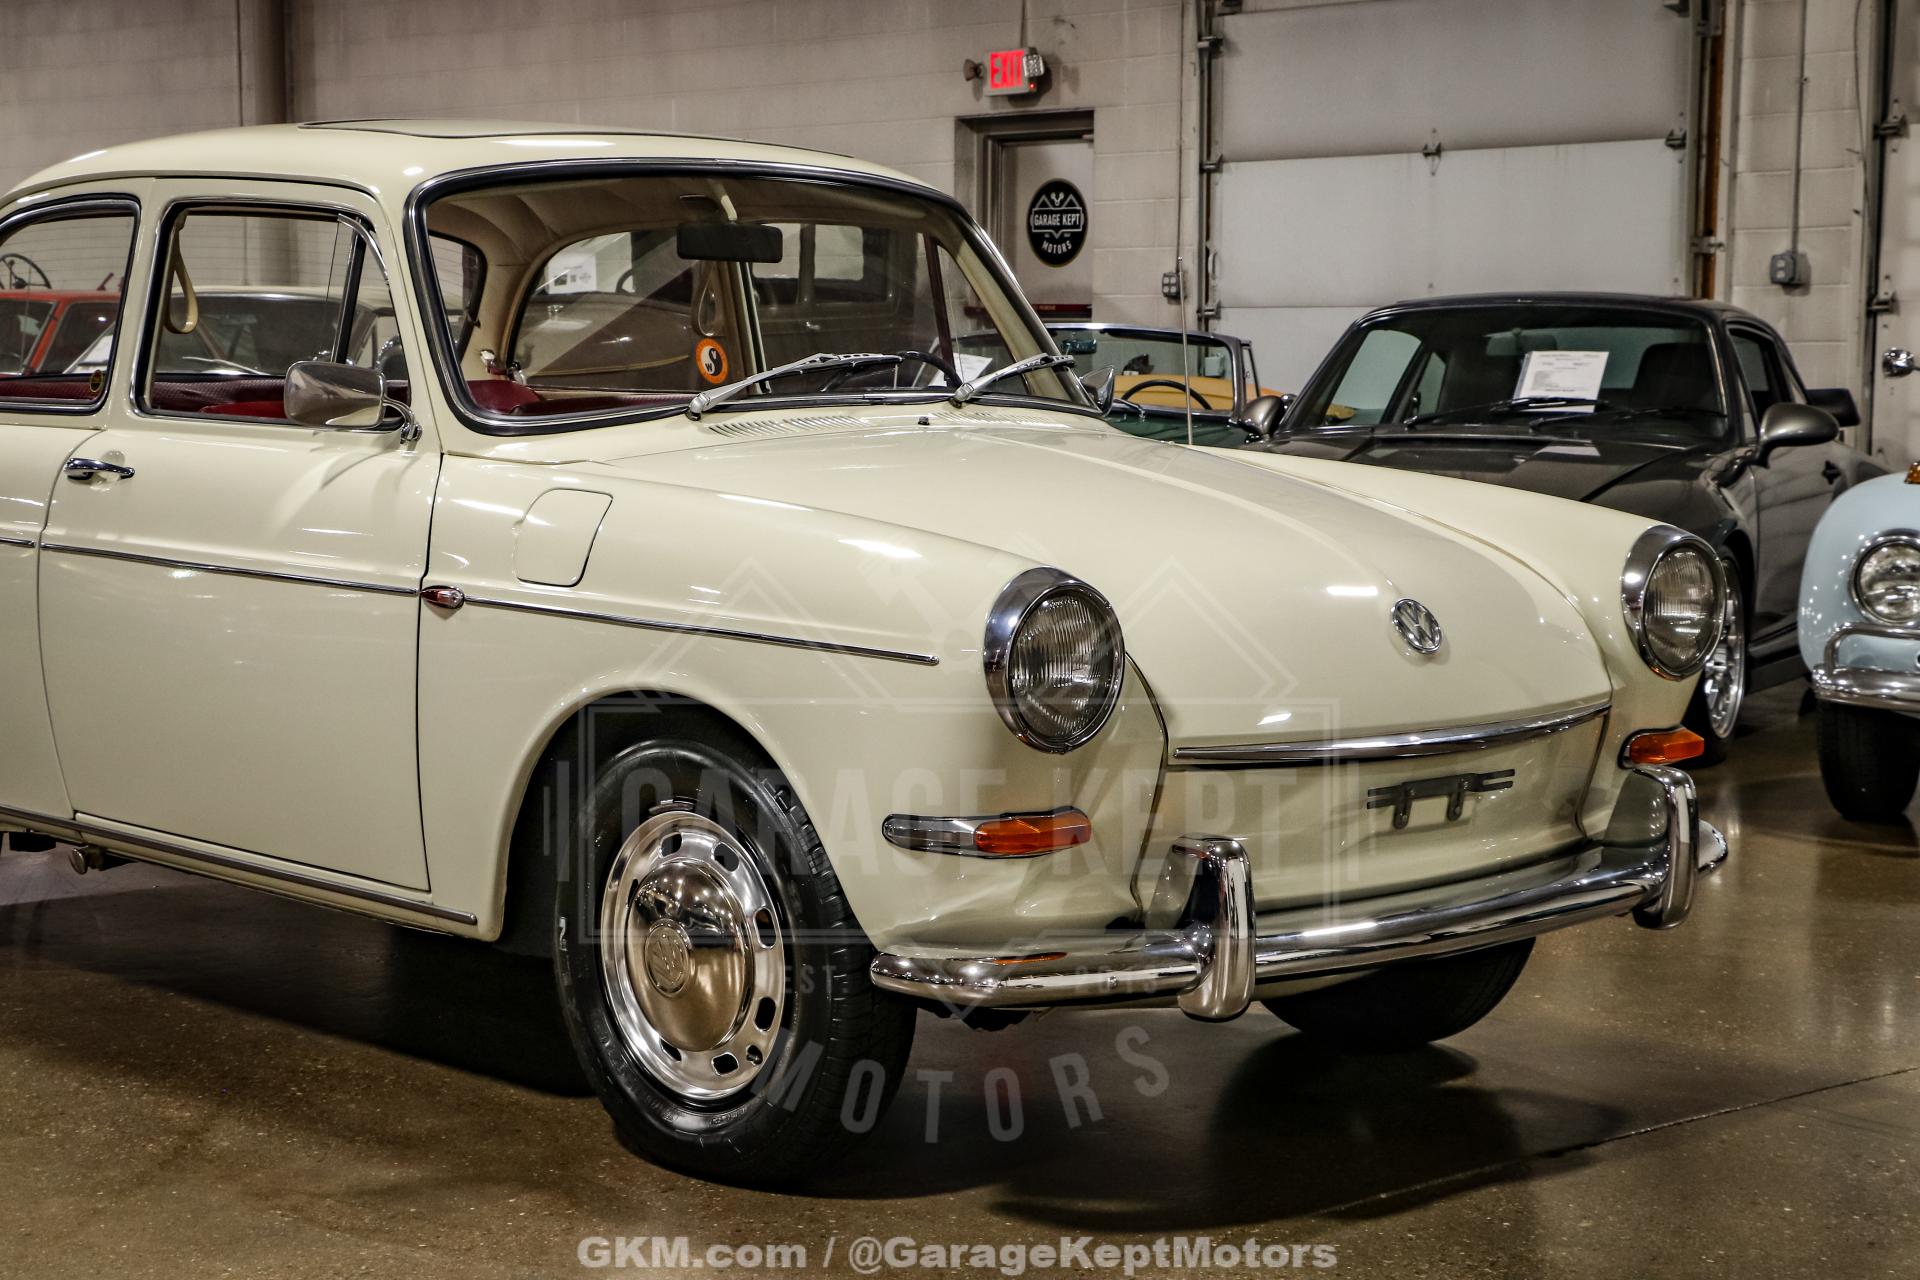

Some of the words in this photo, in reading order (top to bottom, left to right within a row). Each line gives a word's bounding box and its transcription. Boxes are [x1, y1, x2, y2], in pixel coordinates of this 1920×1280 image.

[990, 49, 1024, 89] EXIT
[1034, 214, 1060, 226] GARAGE
[1062, 213, 1080, 226] KEPT
[1041, 240, 1073, 254] MOTORS
